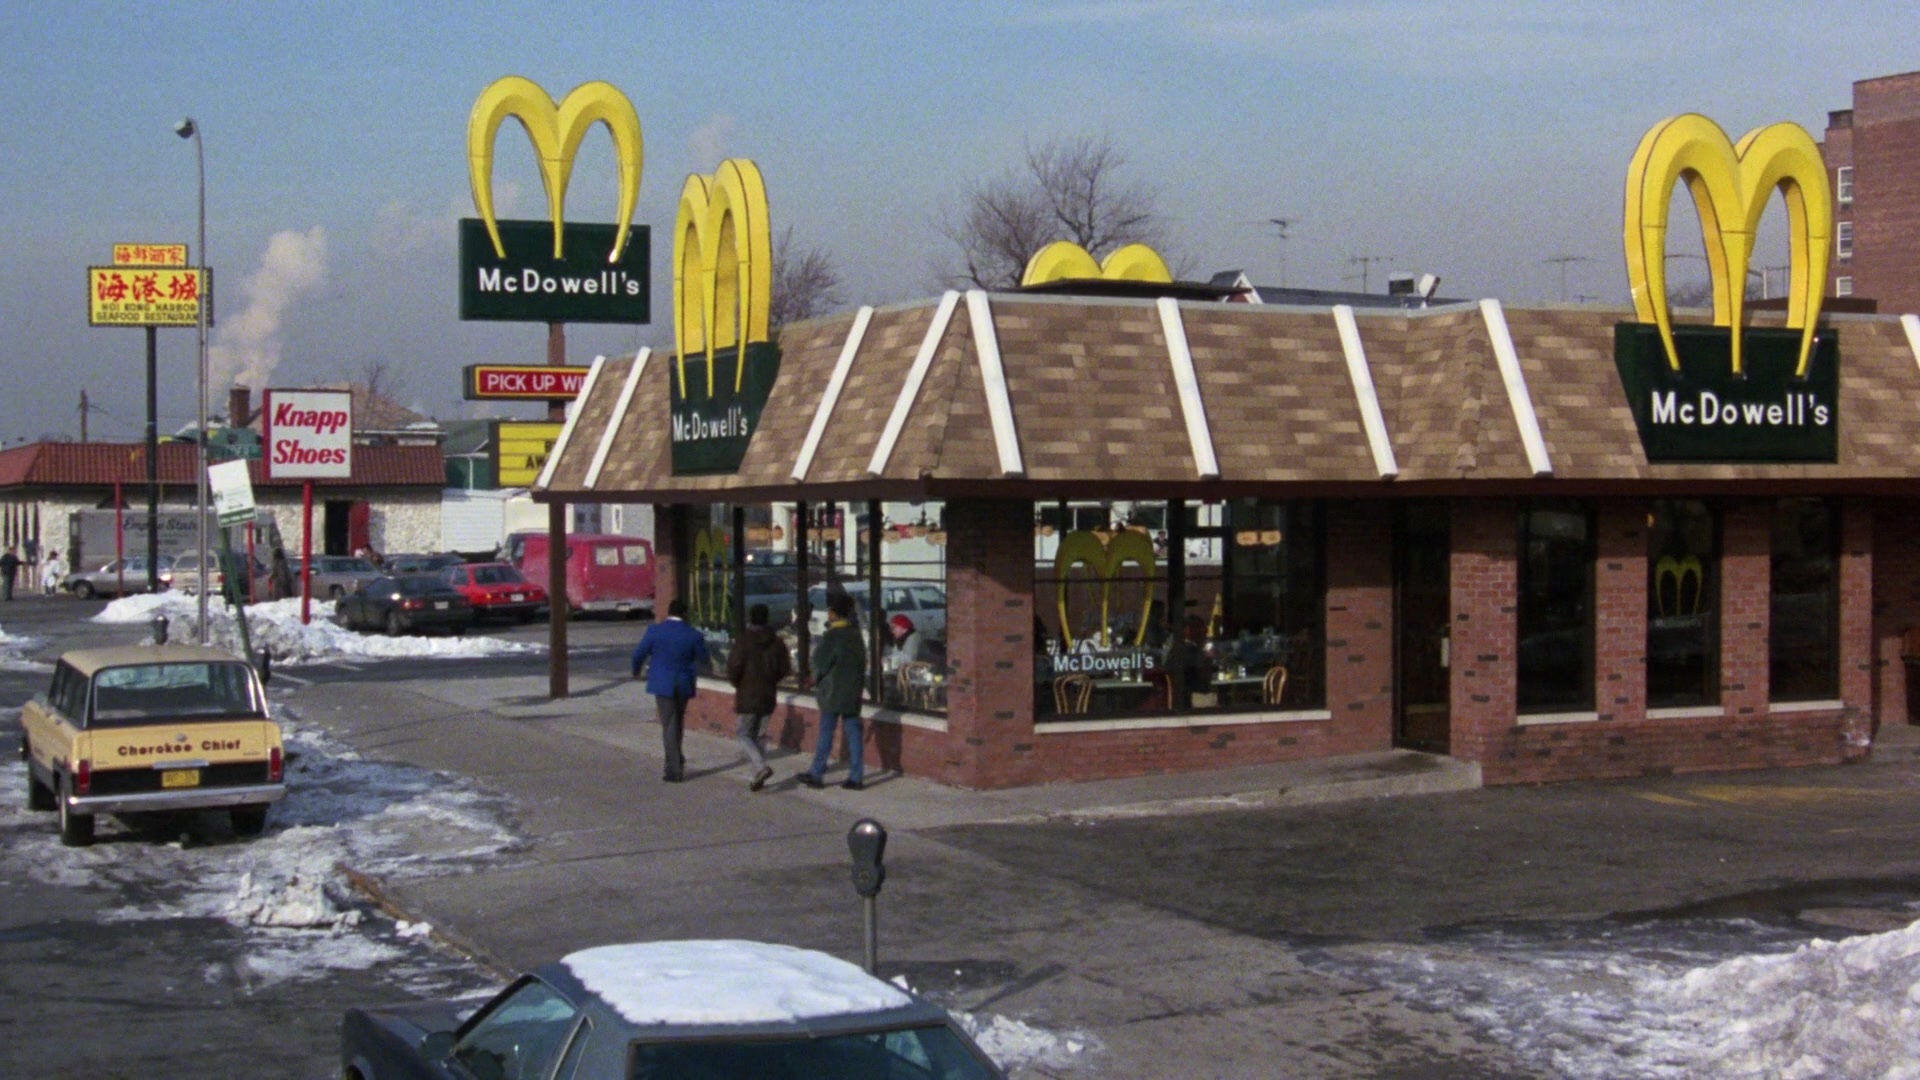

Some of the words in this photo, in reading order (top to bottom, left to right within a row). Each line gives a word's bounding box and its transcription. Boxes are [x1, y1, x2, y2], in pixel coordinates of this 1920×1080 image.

[478, 267, 640, 295] McDowell's
[96, 311, 140, 321] SEAFOOD
[144, 311, 199, 321] RESTAURAN
[156, 303, 196, 312] HARBOR
[487, 374, 527, 391] PICK
[532, 375, 556, 391] UP
[273, 403, 348, 434] Knapp
[1652, 391, 1829, 426] McDowell's
[672, 405, 748, 442] McDowell's
[273, 439, 347, 464] Shoes
[1053, 653, 1155, 672] McDowell's
[117, 743, 193, 757] Cherokee
[201, 739, 241, 751] Chief
